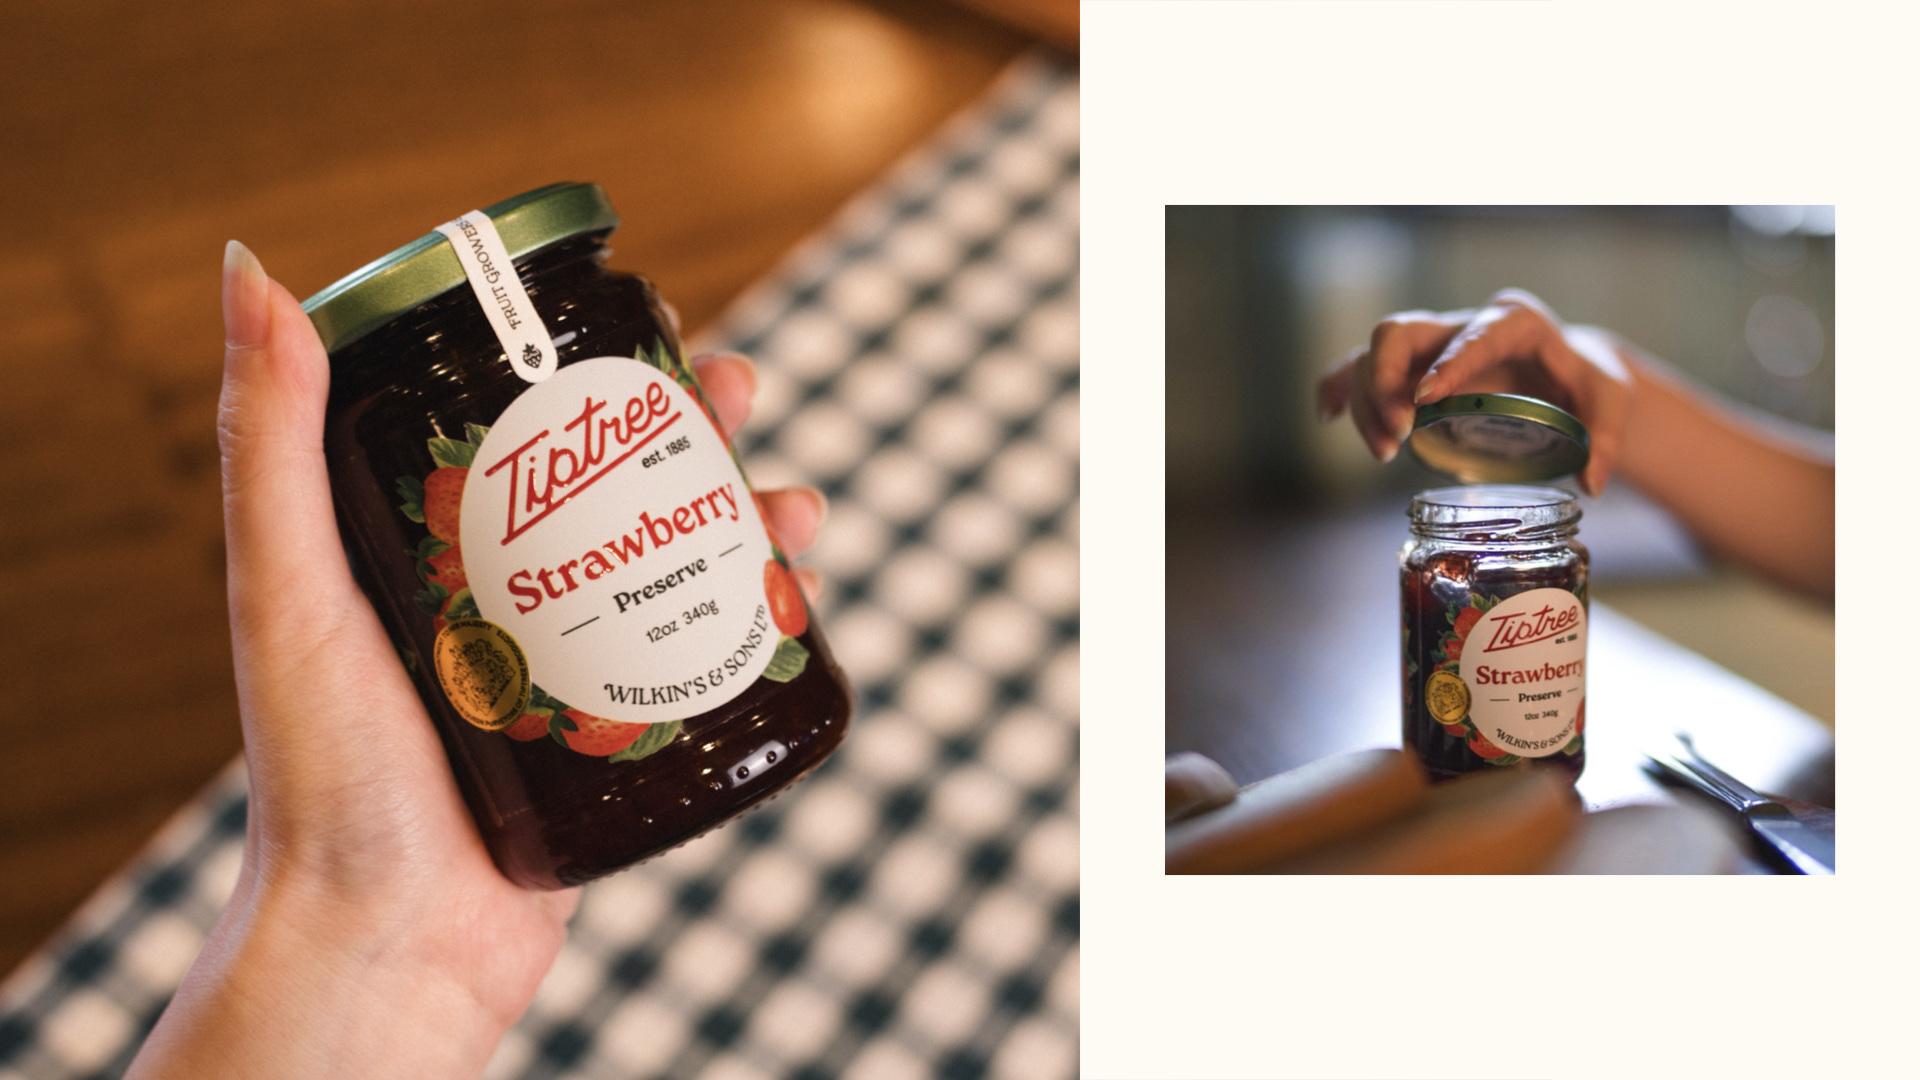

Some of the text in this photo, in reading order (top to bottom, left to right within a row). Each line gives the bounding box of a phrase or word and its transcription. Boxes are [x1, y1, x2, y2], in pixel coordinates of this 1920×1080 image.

[491, 286, 522, 330] FRUIT
[485, 381, 682, 546] Tiptree
[642, 435, 692, 469] est. 1885
[506, 482, 740, 616] Strawberry
[613, 558, 709, 614] Preserve
[646, 599, 720, 643] 12oz 340g
[1483, 605, 1580, 653] Tiptree
[496, 630, 525, 666] PRODUCTS
[603, 675, 708, 706] WILKIN'S
[708, 667, 724, 687] &
[724, 629, 763, 677] SONS
[519, 667, 529, 697] TIPTREE
[1476, 657, 1584, 685] Strawberry
[1518, 690, 1562, 703] Preserve
[1524, 713, 1540, 721] 12oz
[1496, 728, 1569, 750] WILKIN'S & SONS
